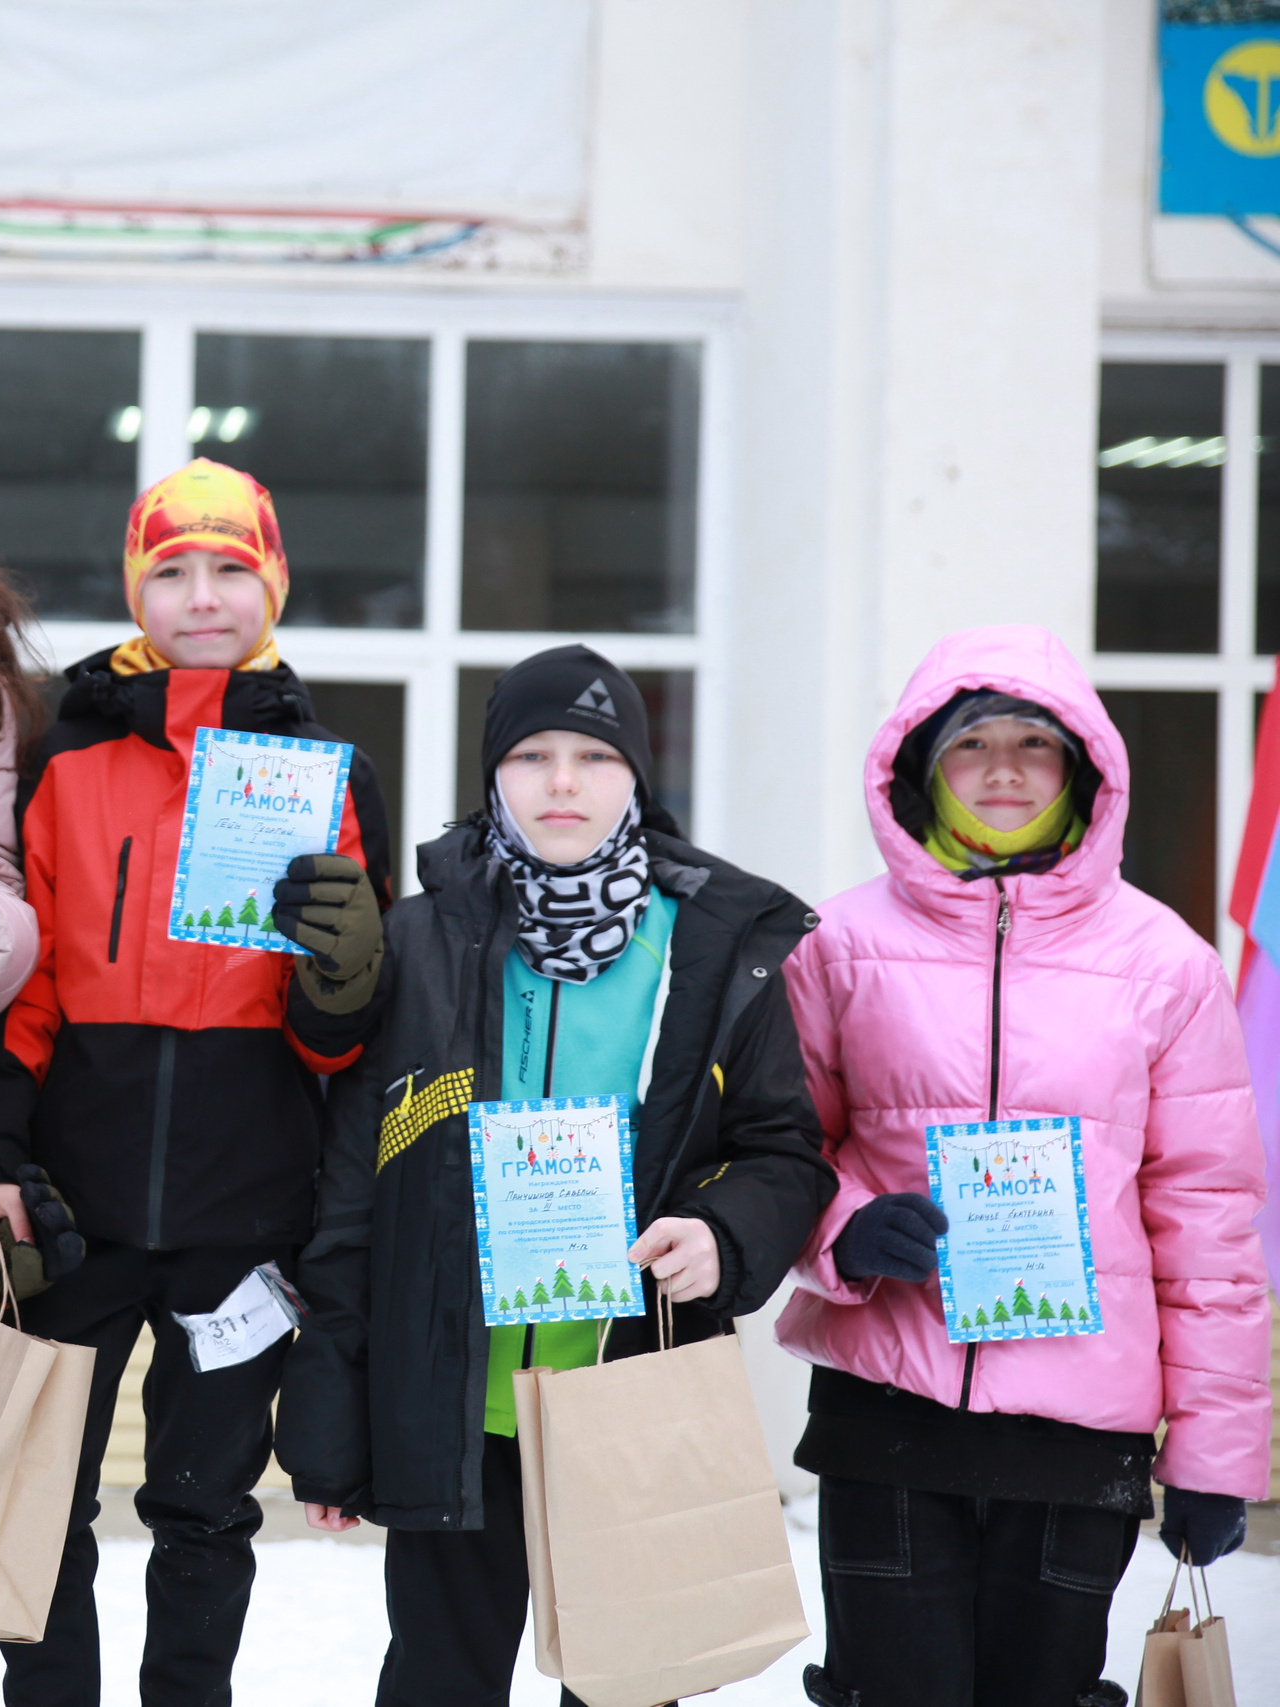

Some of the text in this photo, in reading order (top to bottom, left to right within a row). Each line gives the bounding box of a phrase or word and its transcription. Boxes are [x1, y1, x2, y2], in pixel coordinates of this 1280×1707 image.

[215, 789, 314, 814] ГРАМОТА
[518, 1006, 533, 1084] FISCHER
[501, 1156, 601, 1177] ГРАМОТА
[528, 1179, 578, 1187] Награждается
[958, 1177, 1056, 1198] ГРАМОТА
[508, 1227, 555, 1235] спортивному
[556, 1223, 619, 1231] ориентированию
[552, 1215, 606, 1223] соревнованиях
